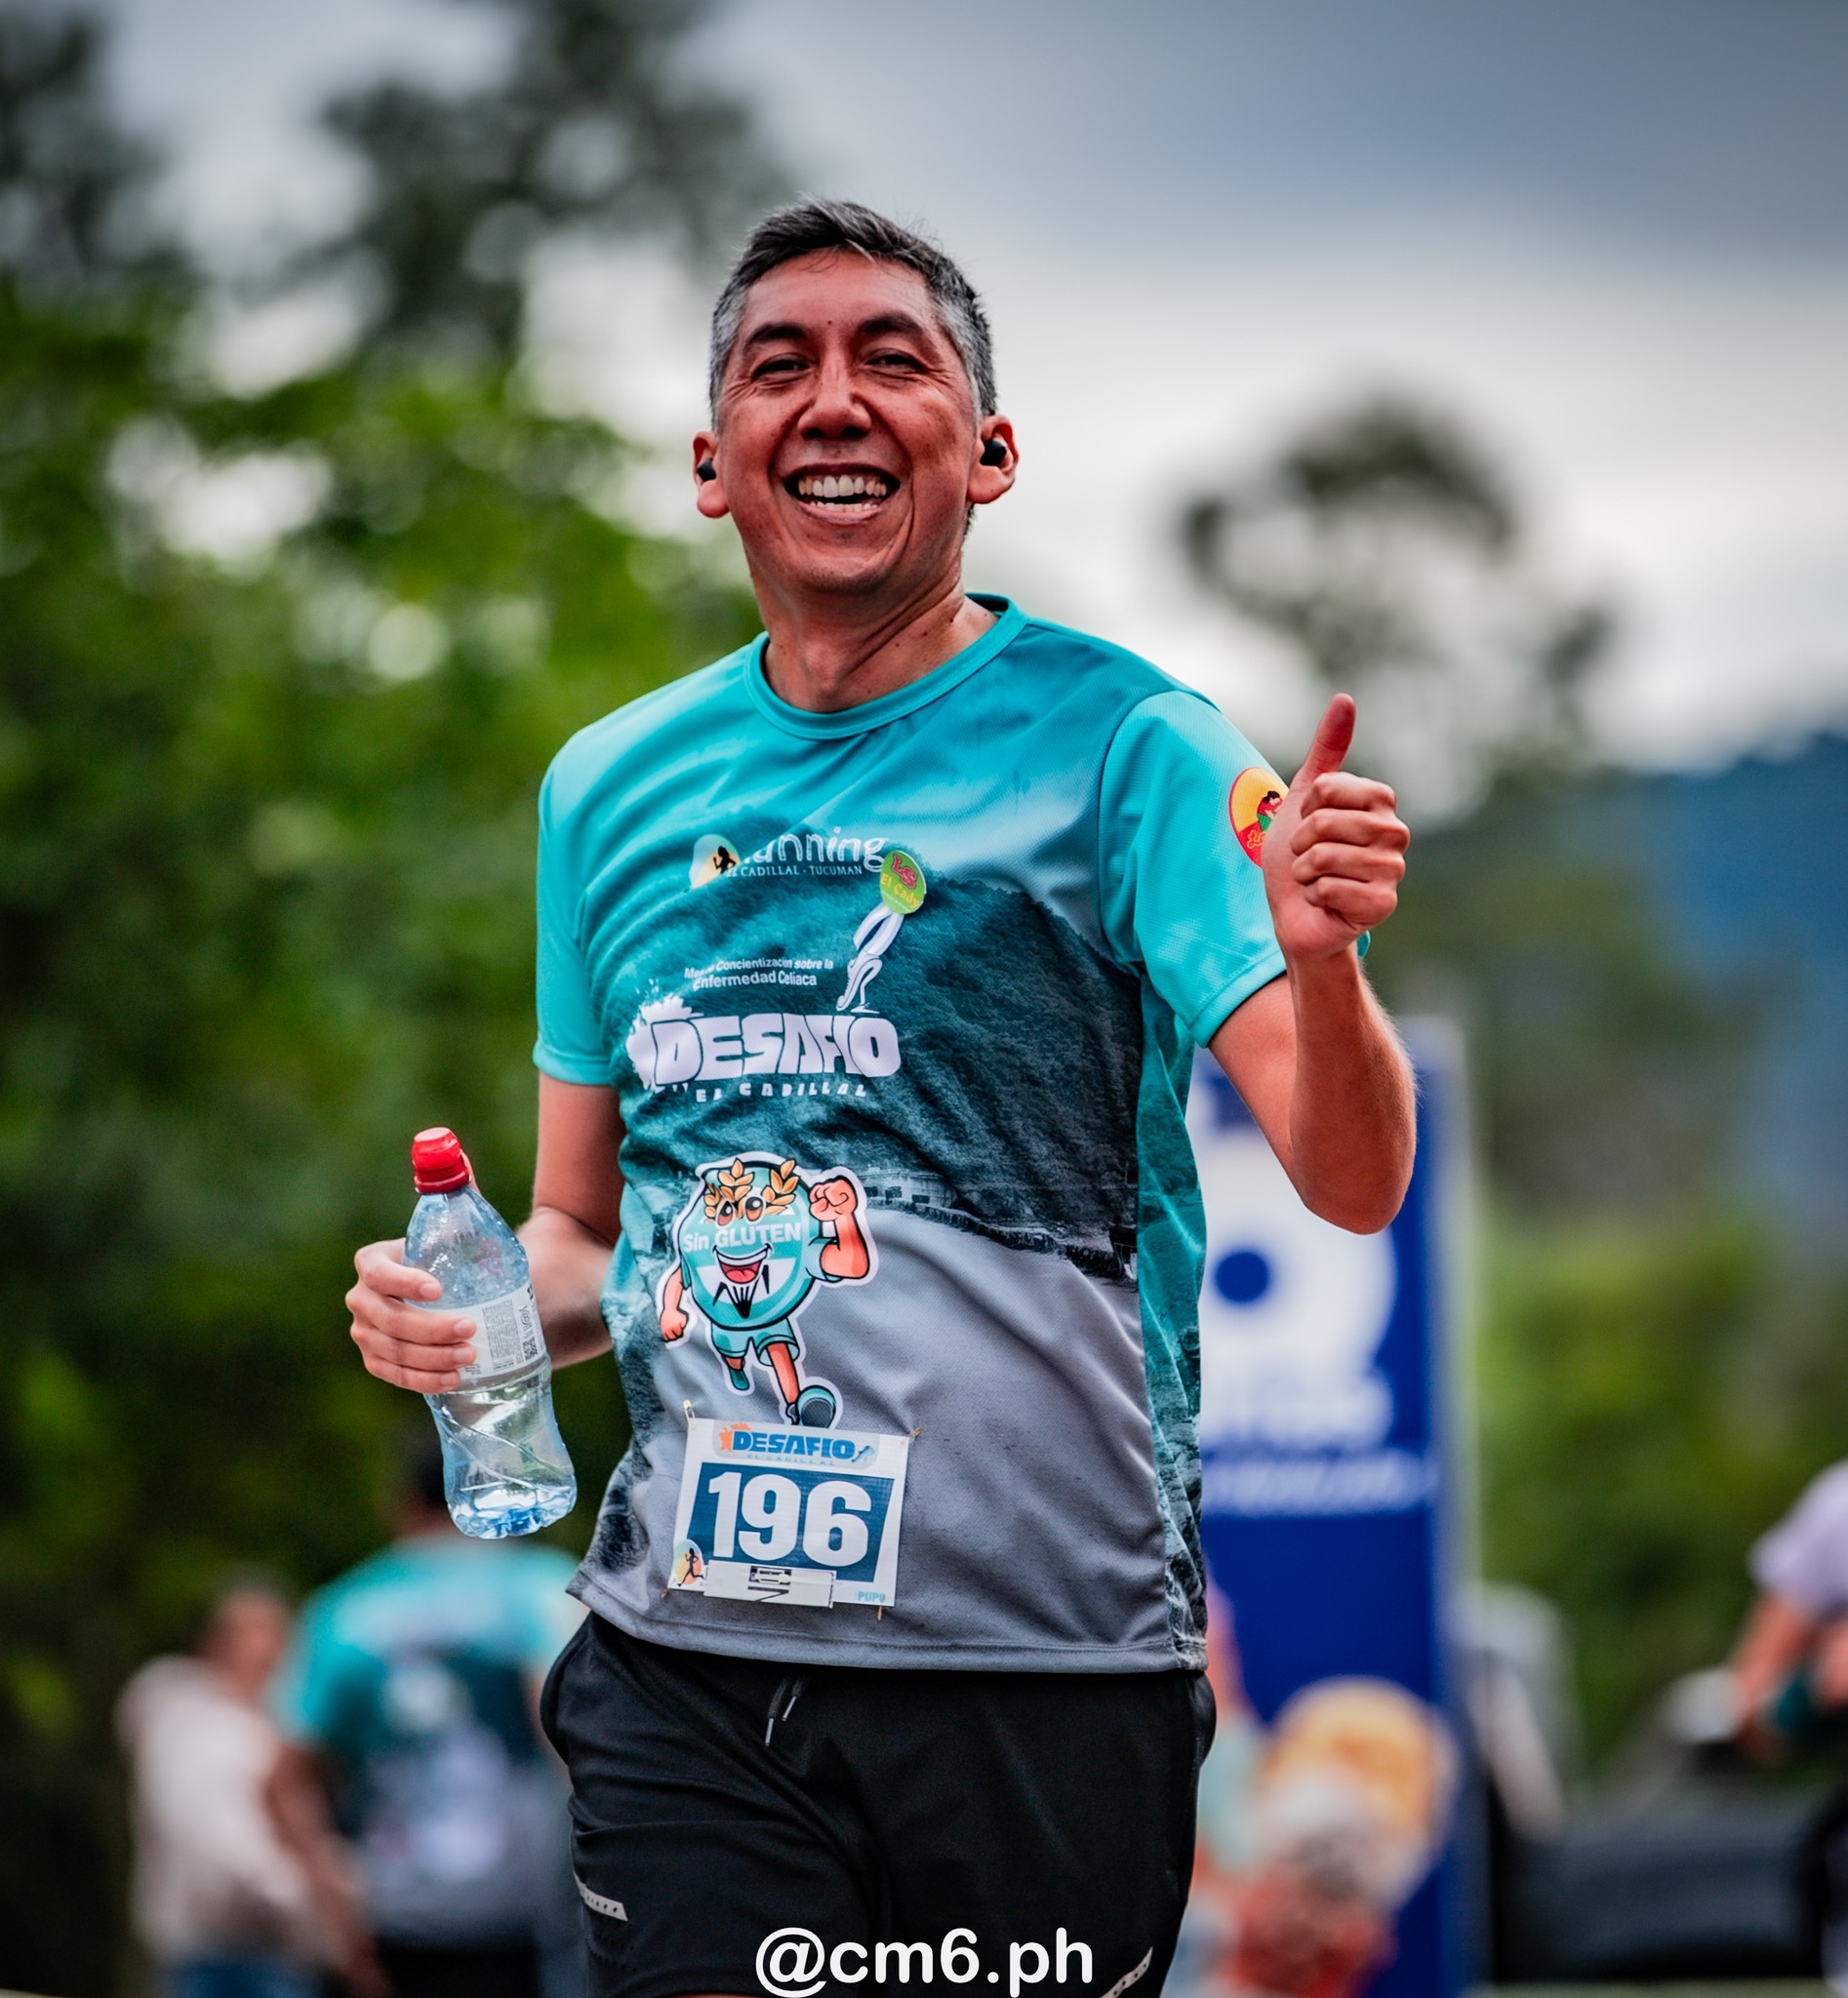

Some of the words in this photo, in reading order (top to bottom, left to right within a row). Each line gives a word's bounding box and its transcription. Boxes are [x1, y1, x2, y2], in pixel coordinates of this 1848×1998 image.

[741, 864, 799, 877] CADILLAL
[809, 865, 863, 875] TUCUMAN
[893, 883, 920, 909] Cady
[794, 959, 823, 970] sobre
[824, 959, 834, 970] la
[693, 971, 777, 992] Enfermedad
[651, 1013, 902, 1086] DESAFIO
[683, 1232, 709, 1254] Sin
[714, 1222, 802, 1249] GLUTEN
[732, 1430, 856, 1460] DESAFIO
[707, 1471, 871, 1567] 196
